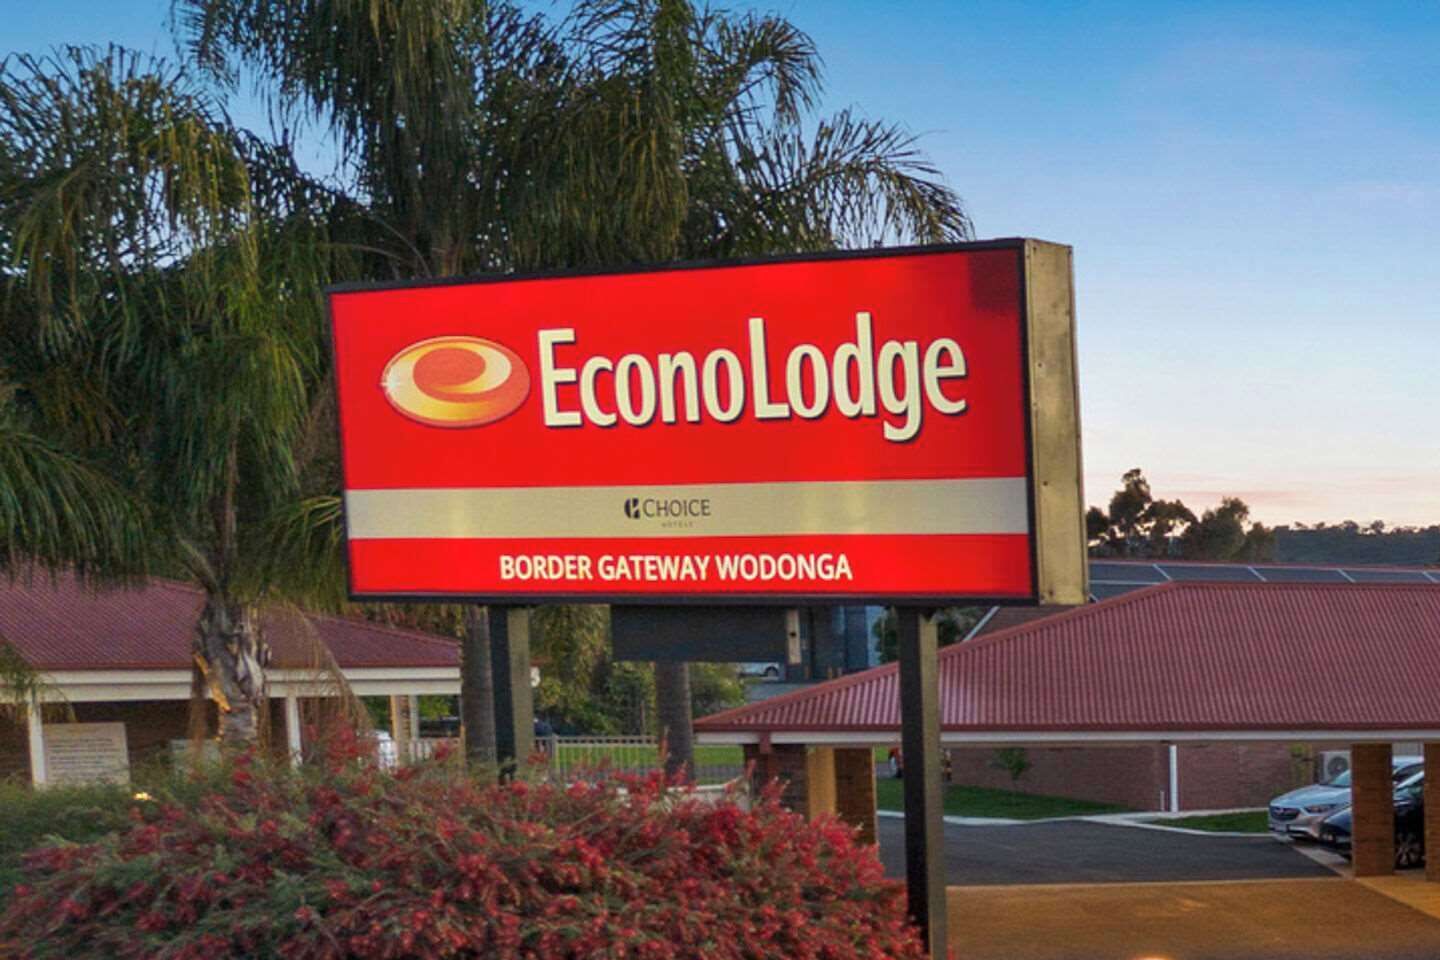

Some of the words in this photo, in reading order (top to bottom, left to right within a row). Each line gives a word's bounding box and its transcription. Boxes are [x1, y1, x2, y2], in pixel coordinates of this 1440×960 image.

[538, 311, 967, 442] EconoLodge
[642, 498, 711, 518] CHOICE
[499, 554, 593, 581] BORDER
[598, 554, 710, 581] GATEWAY
[714, 553, 853, 581] WODONGA
